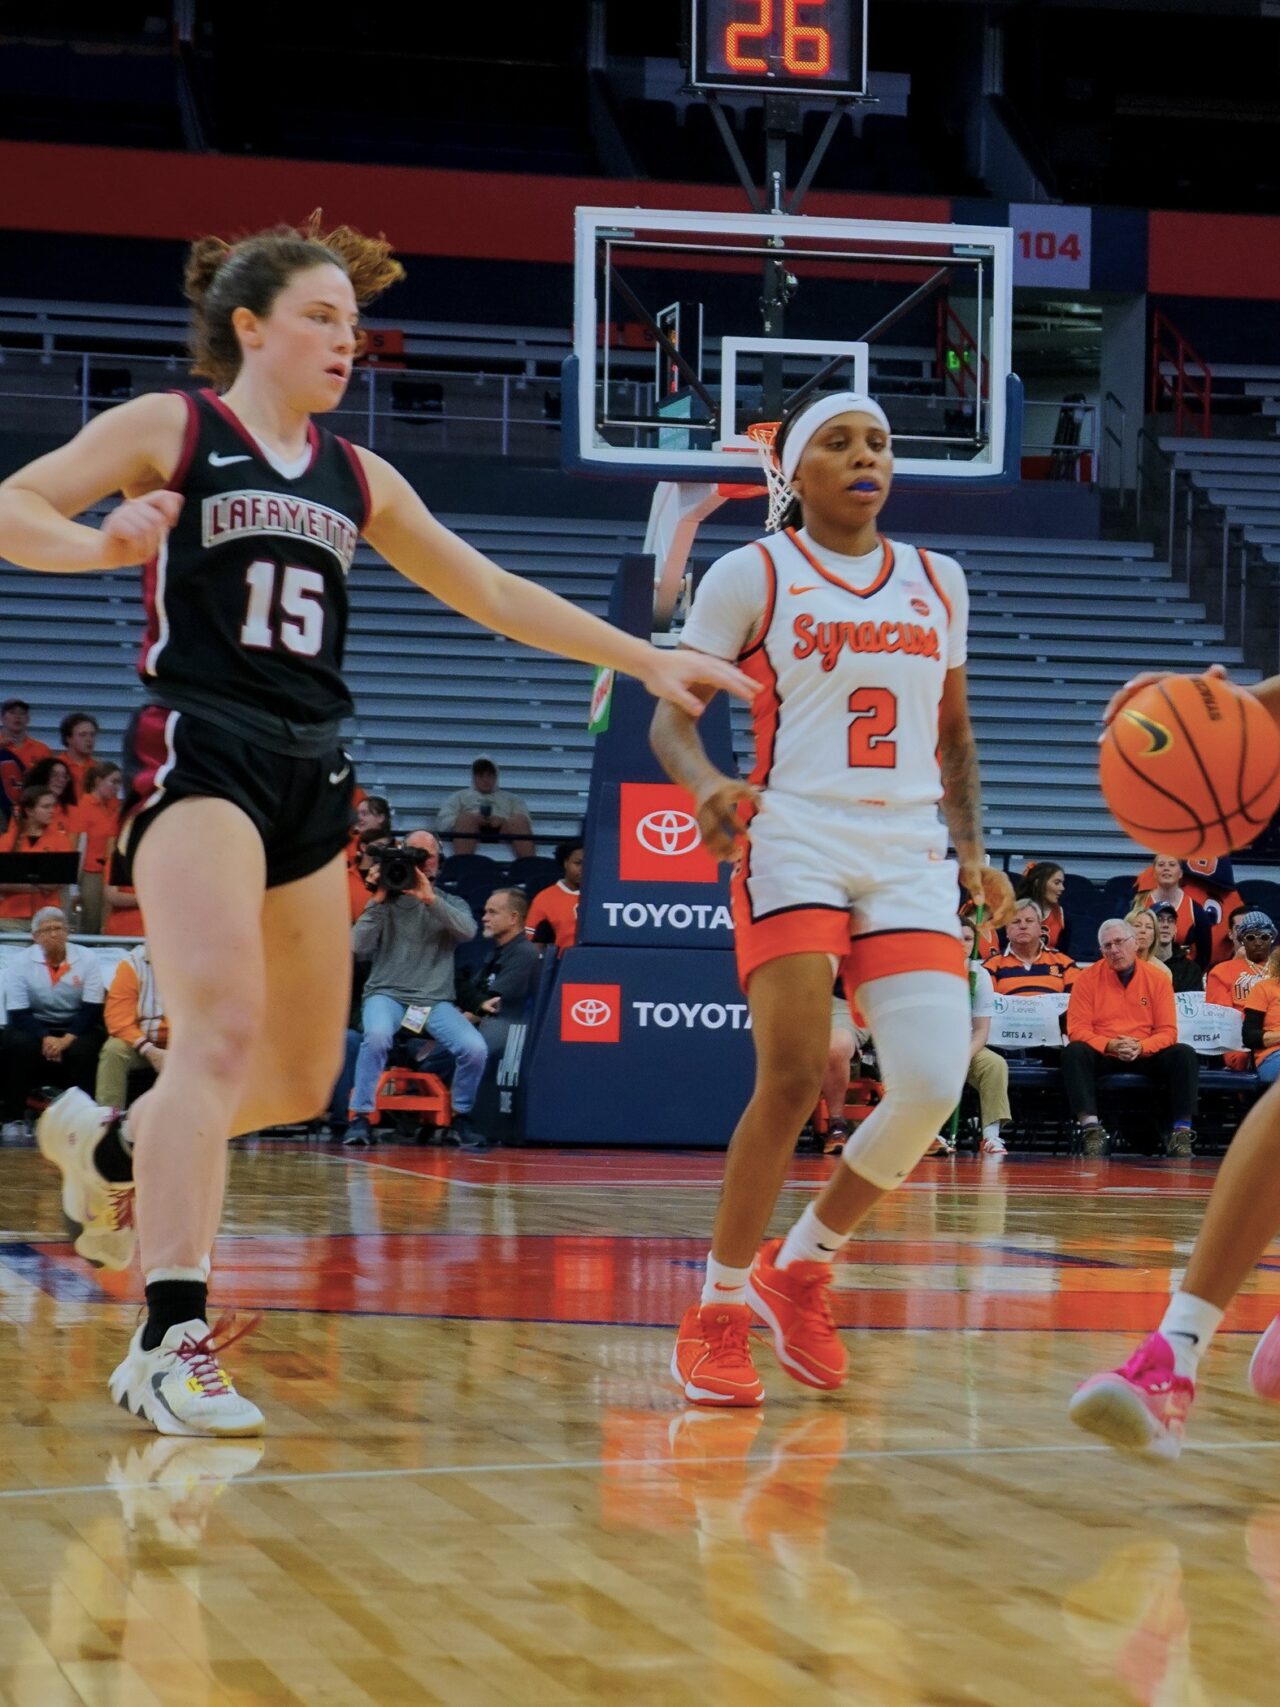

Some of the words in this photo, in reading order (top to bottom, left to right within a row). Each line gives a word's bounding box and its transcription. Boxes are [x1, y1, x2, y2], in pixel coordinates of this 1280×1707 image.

[727, 0, 830, 75] 26
[1018, 231, 1081, 261] 104
[241, 560, 325, 657] 15
[847, 687, 897, 769] 2
[603, 903, 735, 929] TOYOTA
